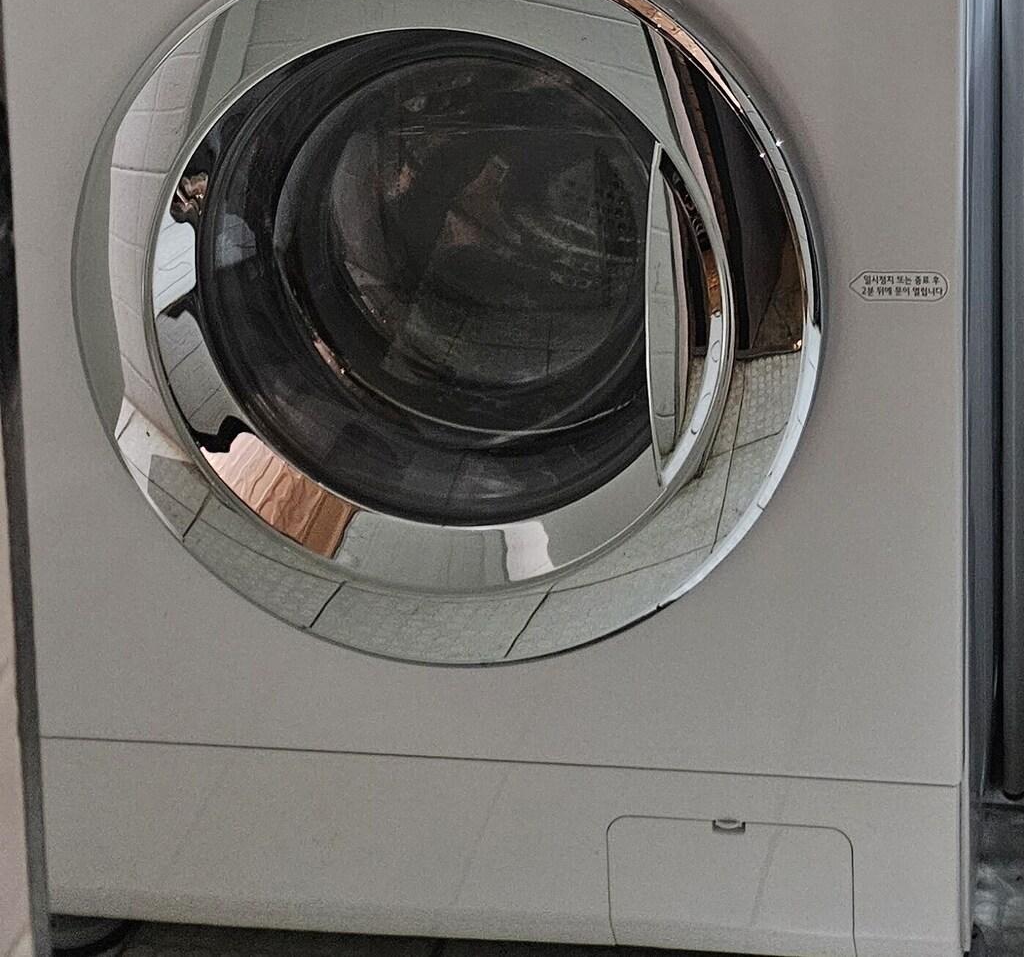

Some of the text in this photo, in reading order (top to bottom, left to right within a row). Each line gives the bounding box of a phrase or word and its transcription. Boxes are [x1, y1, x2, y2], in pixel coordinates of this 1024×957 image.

[863, 275, 895, 285] 일시정지
[896, 275, 912, 285] 또는
[914, 275, 929, 285] 종료
[861, 286, 874, 297] 2분
[895, 286, 911, 297] 문이
[912, 286, 943, 297] 열립니다
